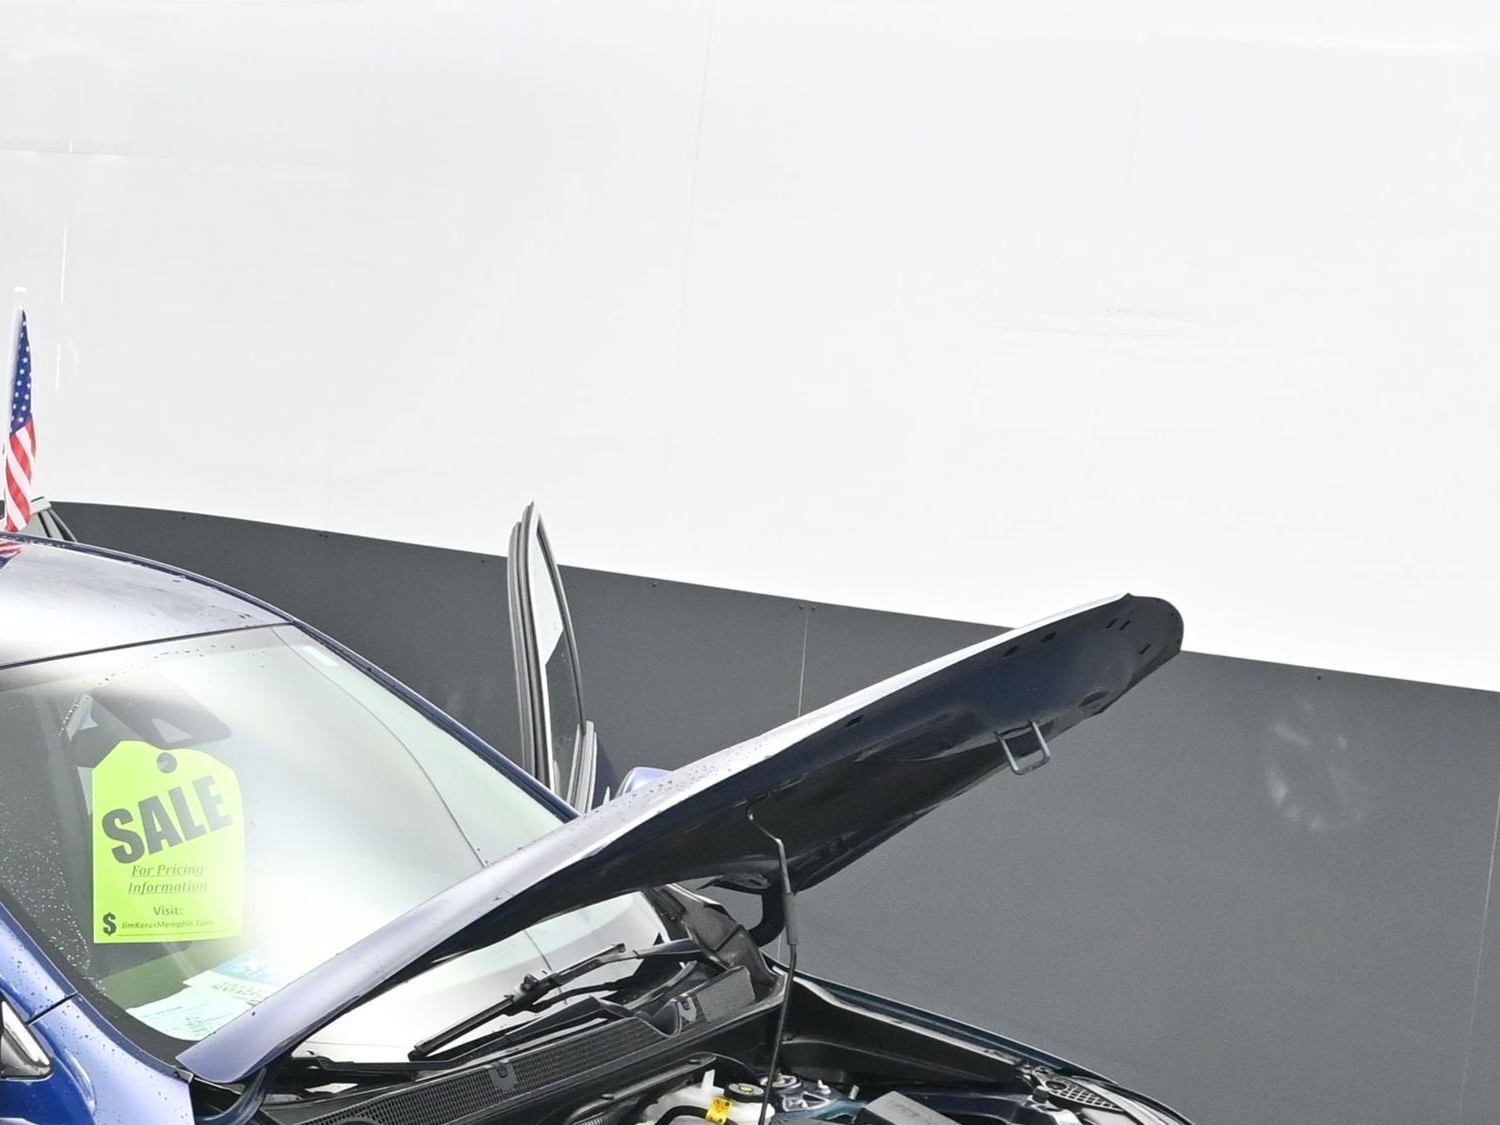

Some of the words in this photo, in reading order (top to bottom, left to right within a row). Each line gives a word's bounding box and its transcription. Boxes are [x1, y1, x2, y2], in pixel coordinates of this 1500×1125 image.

[101, 775, 233, 864] SALE
[132, 864, 154, 877] For
[156, 863, 204, 877] Pricing
[128, 880, 207, 895] Information
[153, 905, 183, 916] Visit:
[102, 912, 117, 936] $
